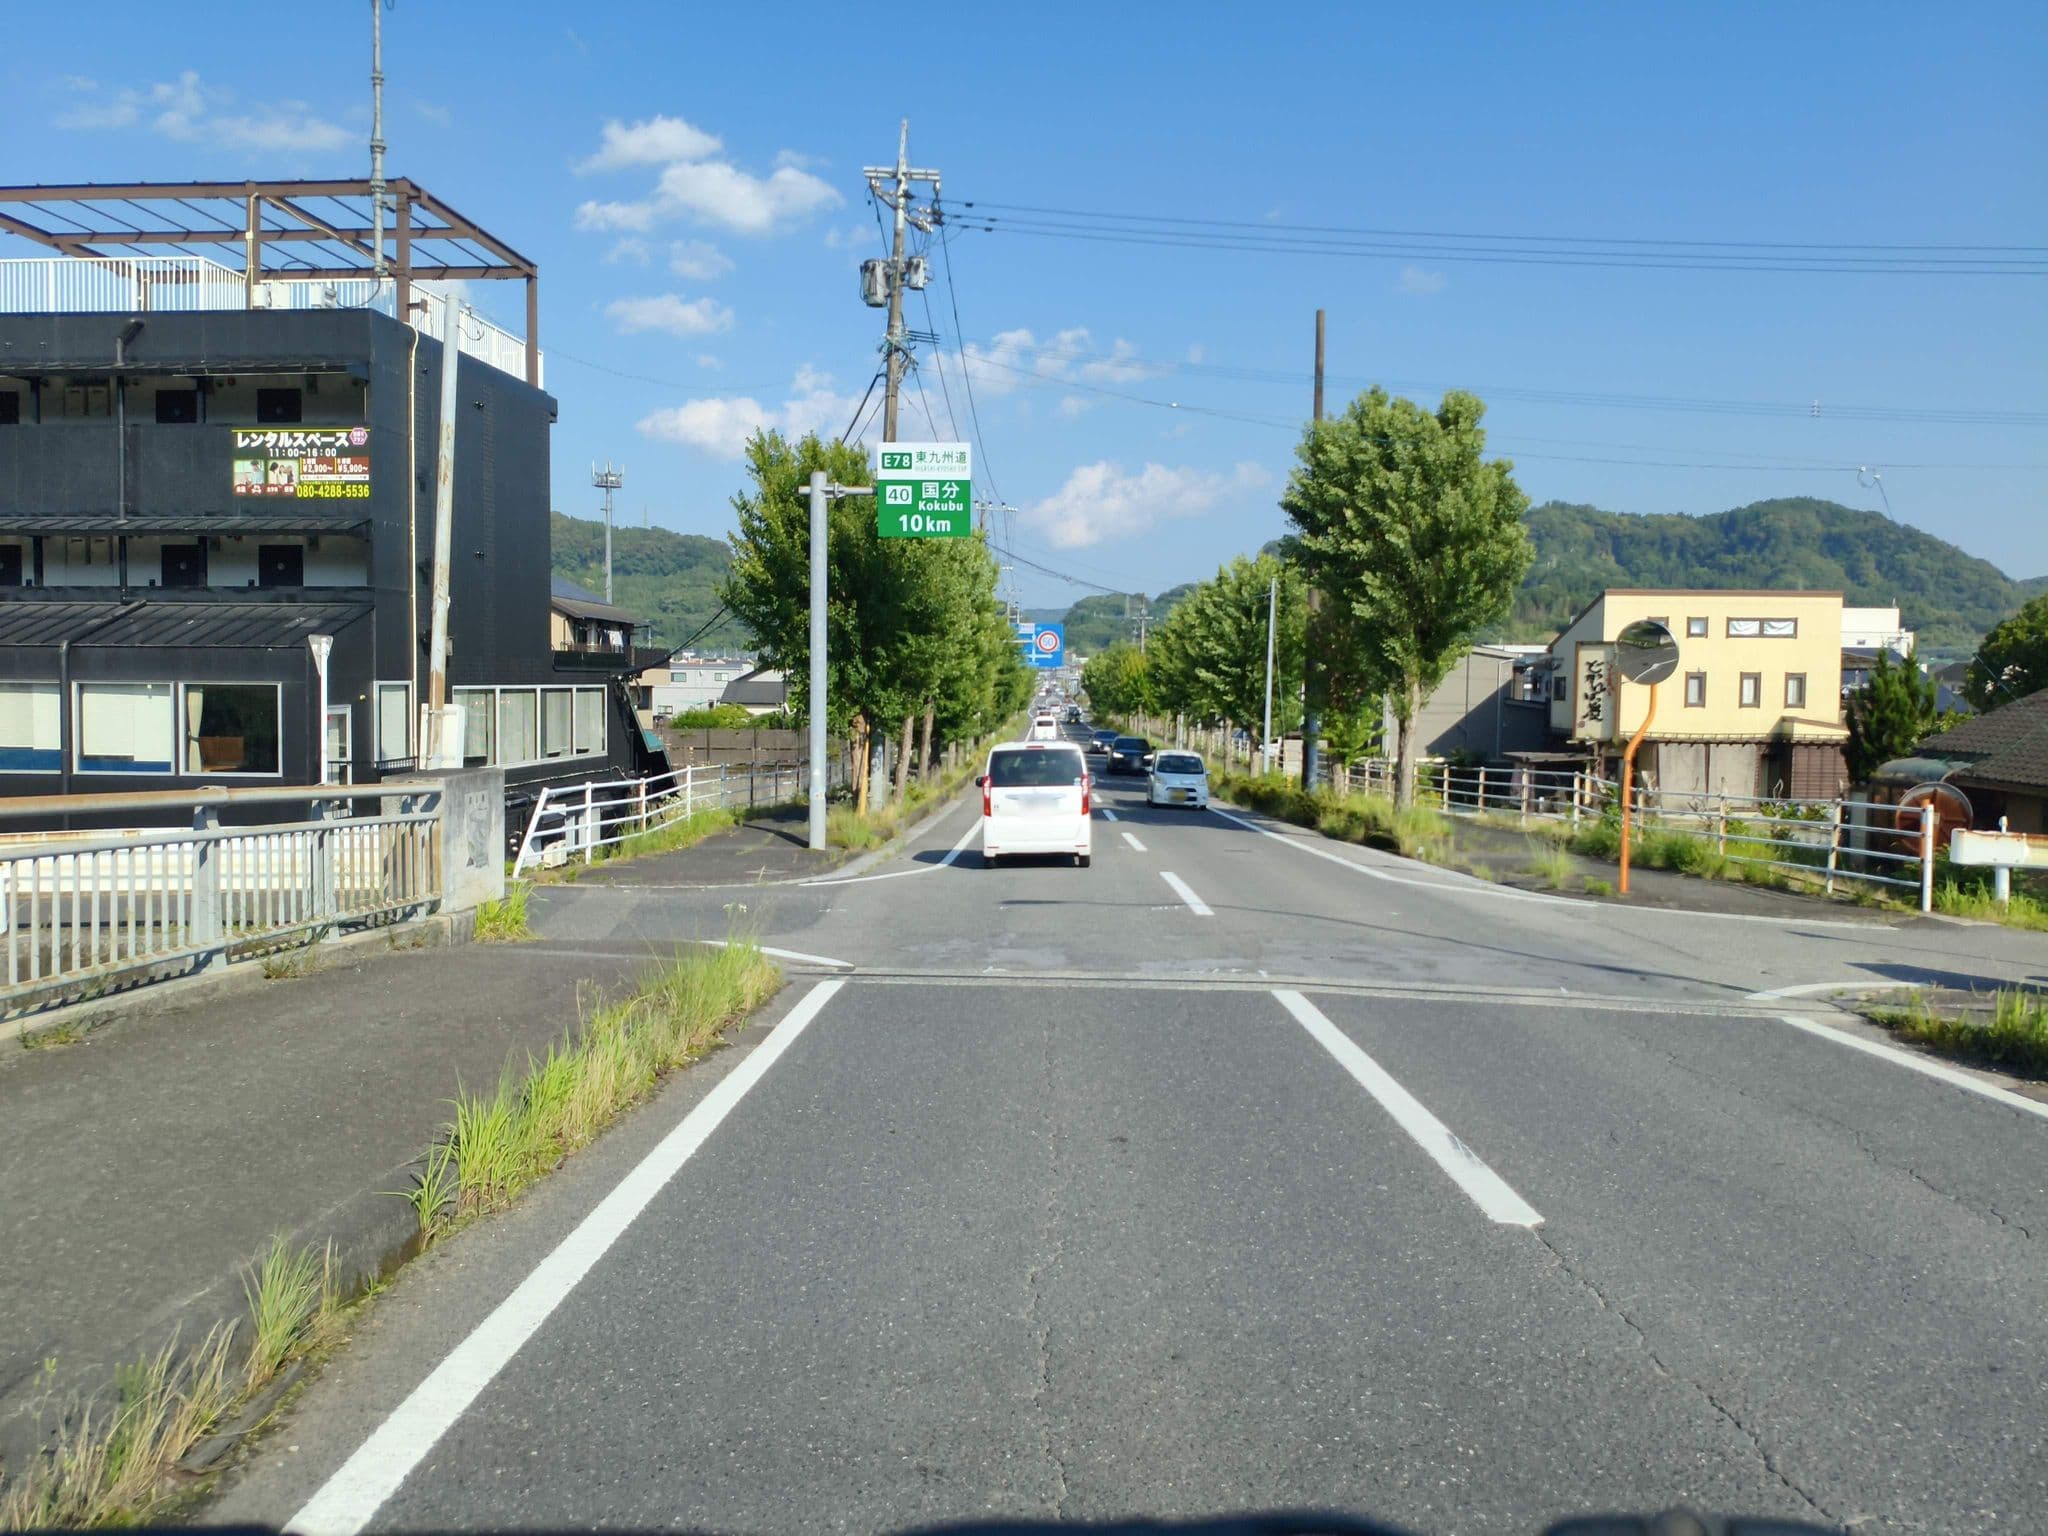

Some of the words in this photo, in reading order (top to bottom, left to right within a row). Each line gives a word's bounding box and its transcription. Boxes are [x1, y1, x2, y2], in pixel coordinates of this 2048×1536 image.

[237, 432, 350, 448] レンタルスペース
[883, 455, 911, 467] E78
[915, 451, 967, 464] 東九州道
[296, 484, 370, 498] 080-4288-5536
[888, 488, 910, 502] 40
[922, 482, 960, 499] 国分
[918, 500, 964, 512] Kokubu
